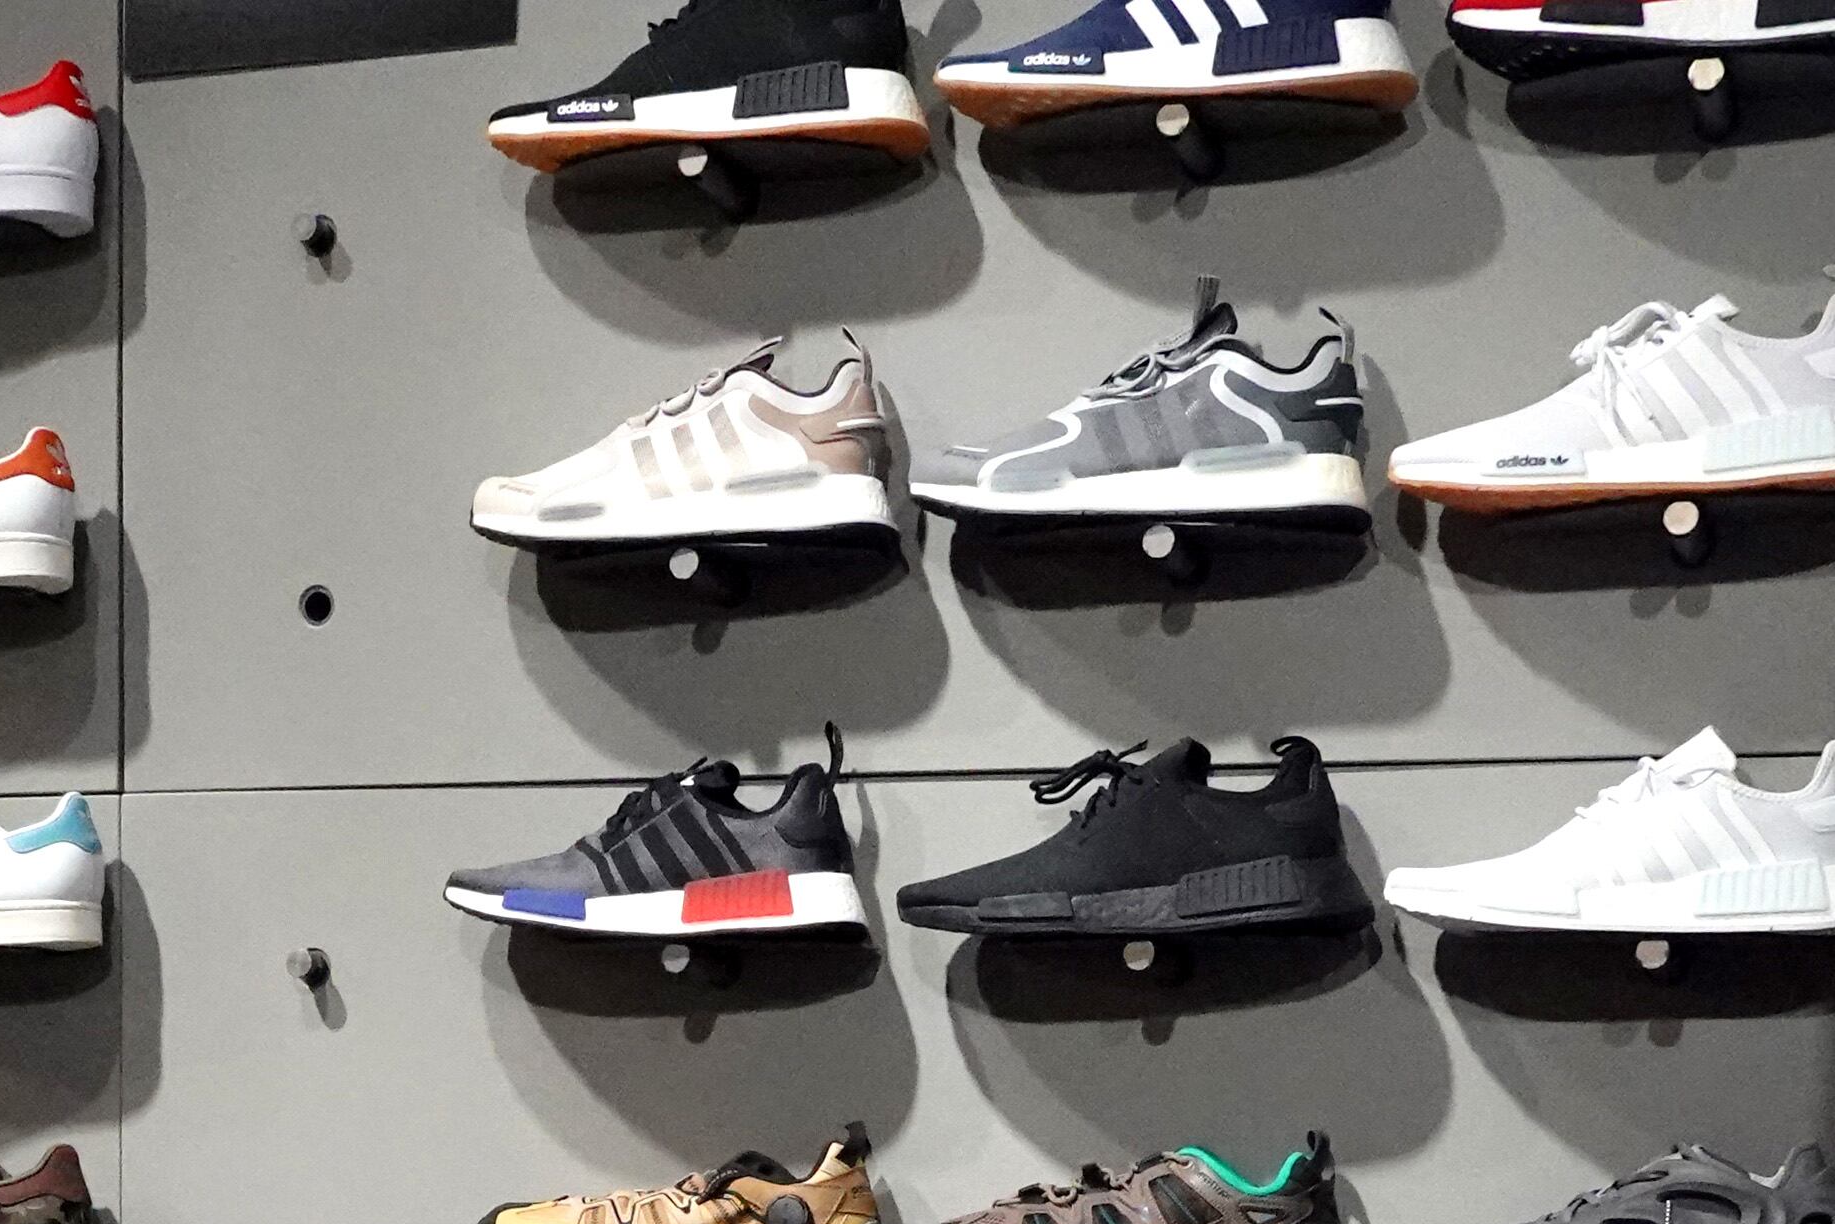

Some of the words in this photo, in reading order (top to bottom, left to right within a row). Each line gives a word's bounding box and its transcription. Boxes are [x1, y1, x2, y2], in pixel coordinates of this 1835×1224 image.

[1023, 51, 1070, 66] adidas
[556, 100, 600, 115] adidas
[1496, 454, 1547, 469] adidas
